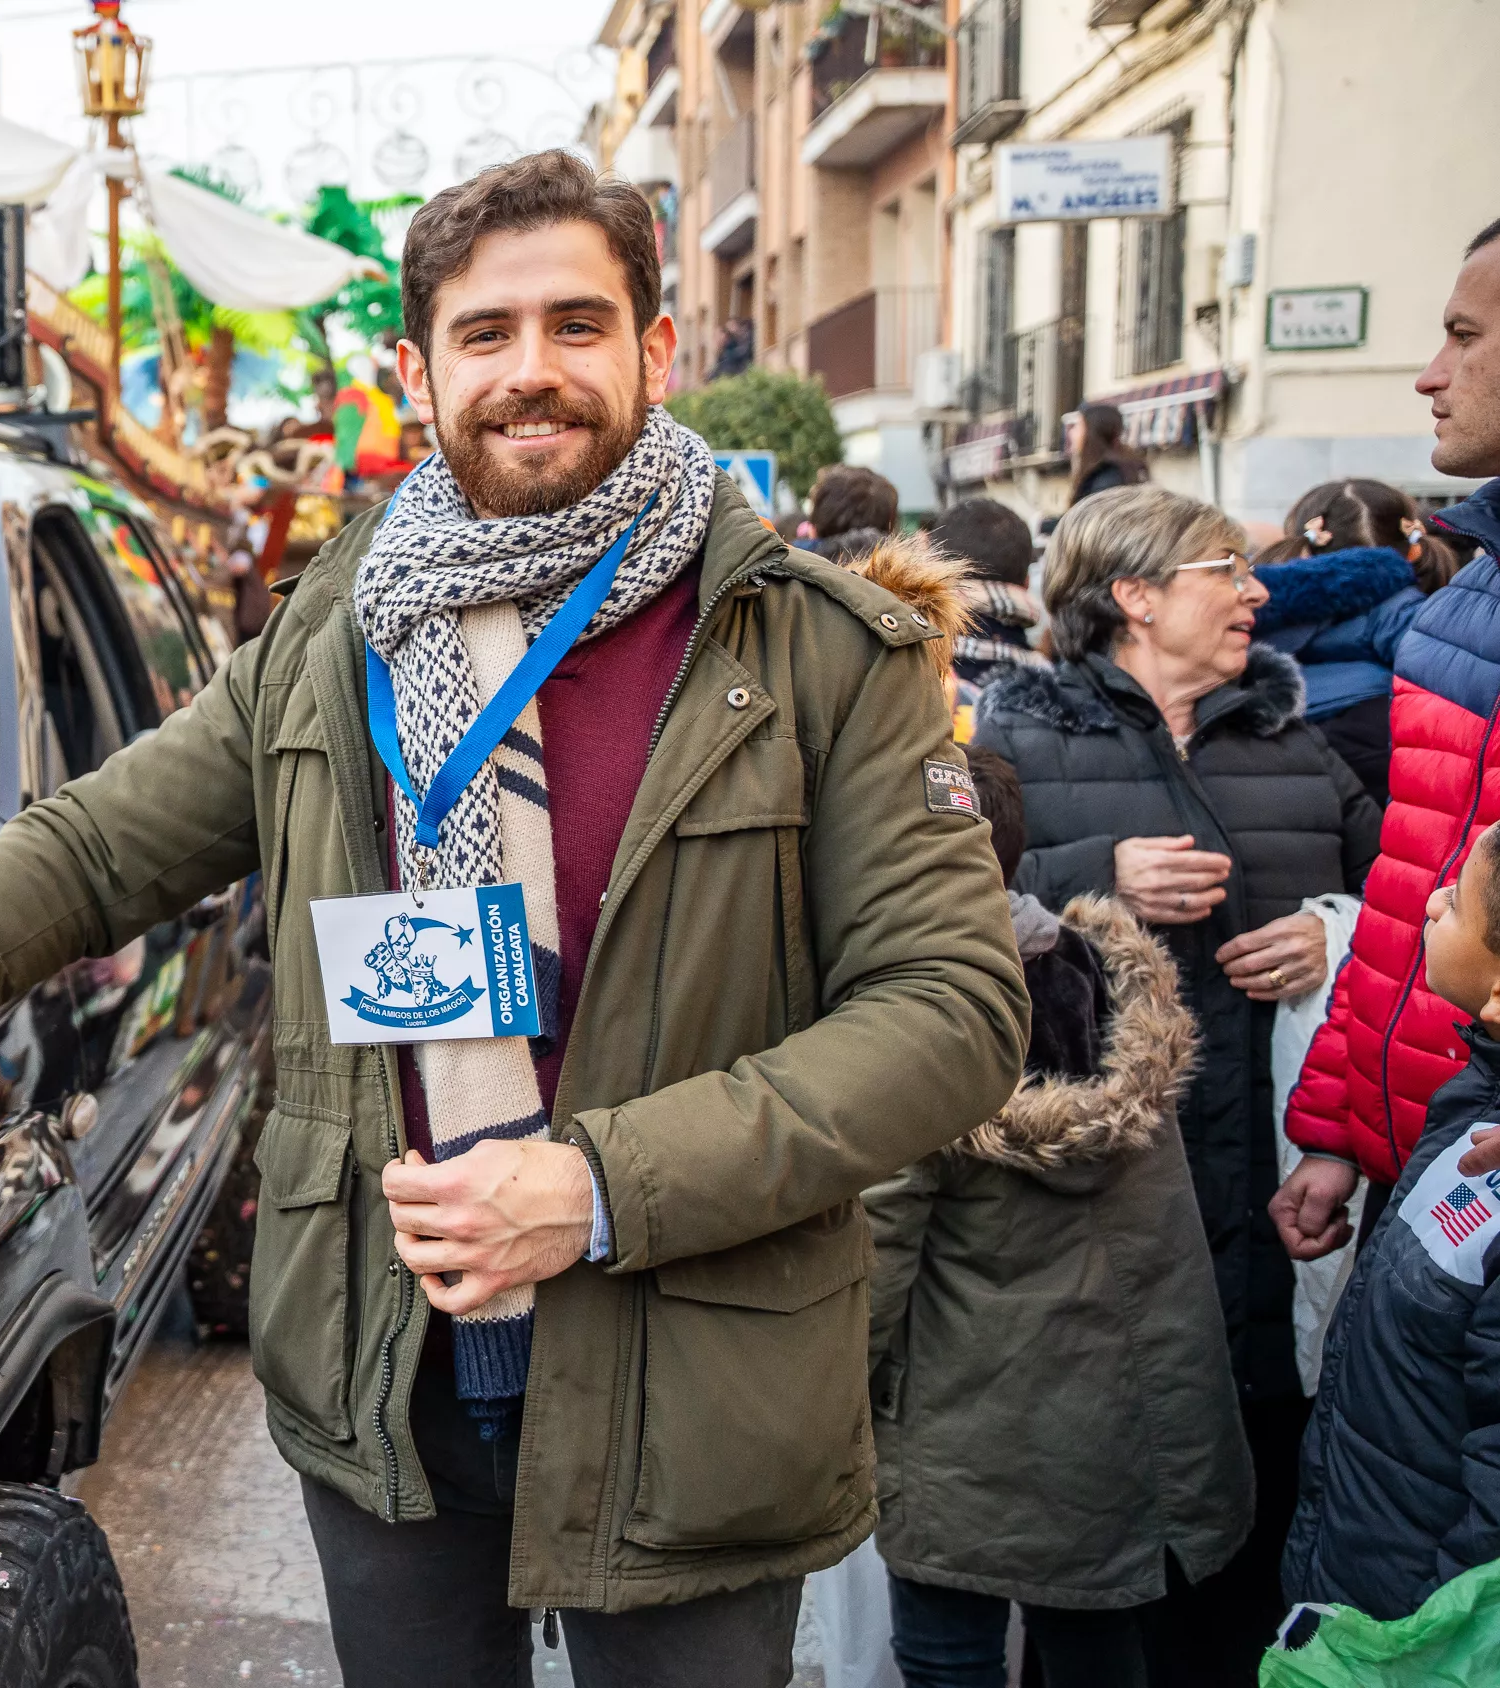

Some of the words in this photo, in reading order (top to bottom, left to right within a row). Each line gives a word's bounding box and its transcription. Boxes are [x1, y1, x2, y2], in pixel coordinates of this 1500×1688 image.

[1061, 188, 1160, 211] ANGELES
[1282, 322, 1350, 340] VIANA
[486, 903, 514, 1025] ORGANIZACIÓN
[507, 922, 530, 1007] CABALGATA
[360, 1001, 381, 1016] PEÑA
[381, 1010, 412, 1020] AMIGOS
[412, 1011, 424, 1020] DE
[424, 1008, 440, 1019] LOS
[441, 994, 467, 1013] MAGOS
[404, 1019, 427, 1027] Lucena
